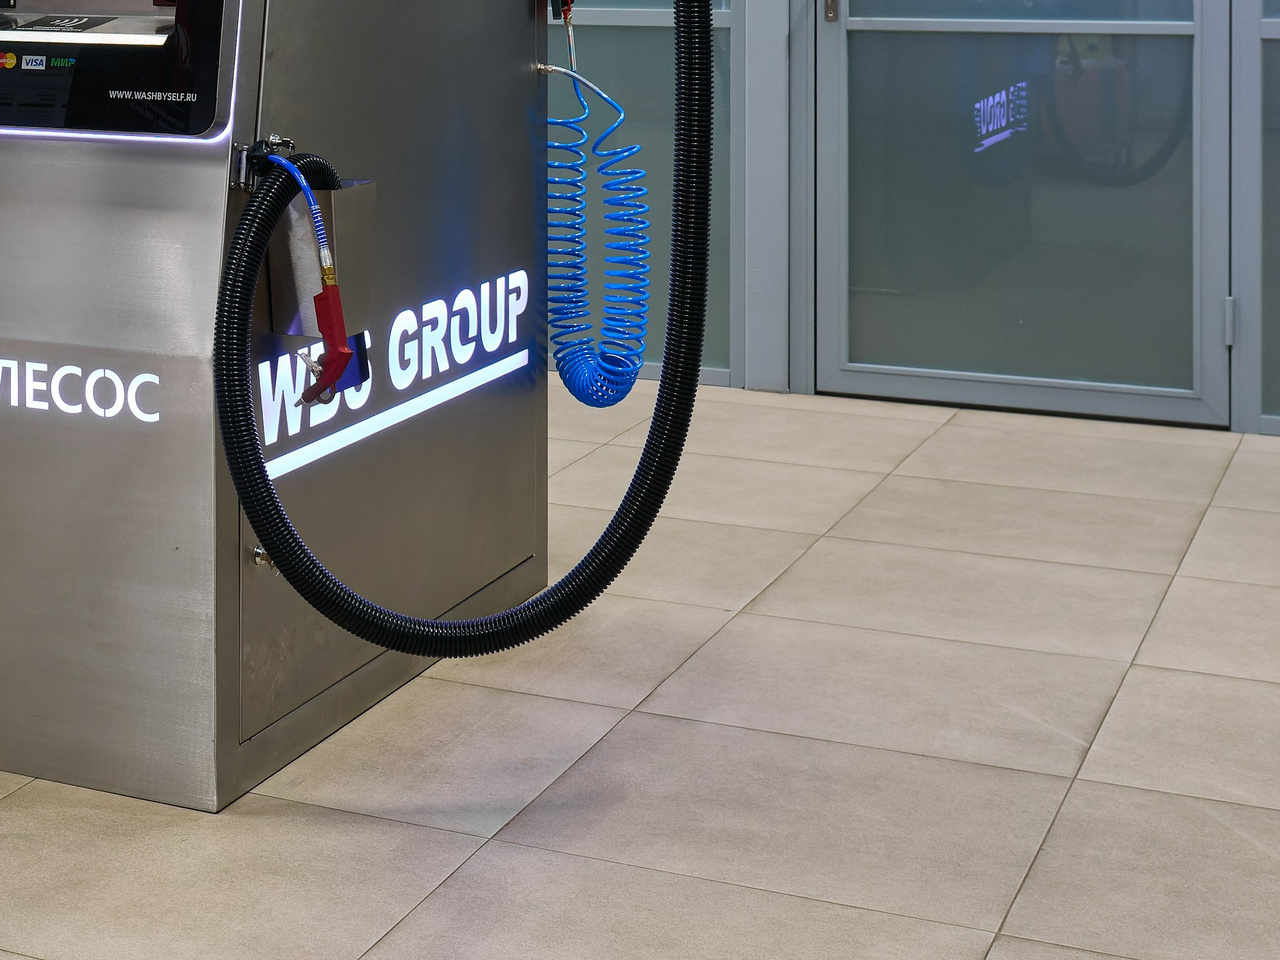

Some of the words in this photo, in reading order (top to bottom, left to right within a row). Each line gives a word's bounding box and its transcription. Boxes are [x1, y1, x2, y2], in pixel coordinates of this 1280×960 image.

[24, 58, 44, 67] VISA
[50, 57, 76, 67] МИР
[109, 90, 197, 102] WWW.WASHBYSELF.RU
[388, 269, 529, 391] GROUP
